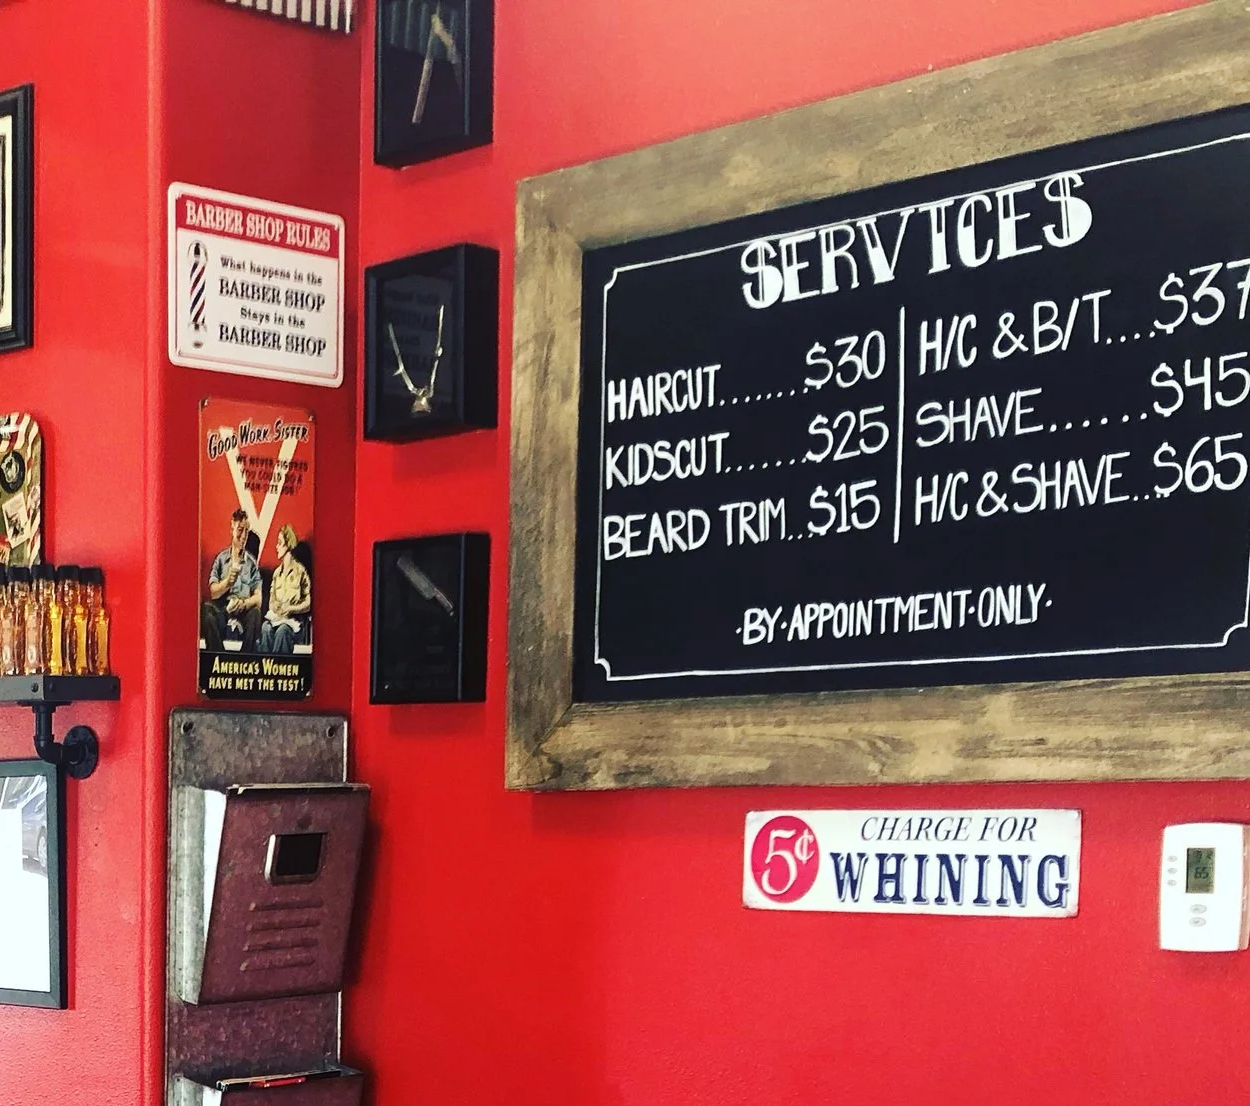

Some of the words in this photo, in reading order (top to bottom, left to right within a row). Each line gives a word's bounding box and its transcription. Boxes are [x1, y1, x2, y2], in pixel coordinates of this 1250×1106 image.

[185, 199, 244, 236] BARBER
[246, 213, 285, 242] SHOP
[286, 220, 331, 252] RULES
[220, 254, 246, 271] What
[250, 261, 291, 281] happens
[294, 268, 303, 281] in
[306, 271, 323, 286] the
[218, 277, 281, 306] BARBER
[285, 288, 325, 314] SHOP
[240, 306, 270, 326] Stays
[274, 313, 285, 326] in
[287, 314, 306, 329] the
[219, 323, 282, 351] BARBER
[285, 332, 327, 358] SHOP
[919, 314, 977, 376] H/C
[1151, 351, 1250, 417] $45
[208, 432, 238, 459] GOOD
[239, 421, 270, 445] WORK
[274, 419, 308, 440] SISTER
[915, 471, 968, 525] H/C
[1154, 433, 1249, 497] $65
[604, 509, 710, 560] BEARD
[208, 677, 232, 689] HAVE
[235, 678, 254, 690] MET
[257, 678, 274, 691] THE
[277, 678, 304, 692] TEST!
[212, 655, 260, 675] AMERICA'S
[262, 657, 299, 676] WOMEN
[761, 828, 815, 896] 5¢
[860, 815, 974, 843] CHARGE
[979, 817, 1038, 843] FOR
[830, 852, 1071, 909] WHINING
